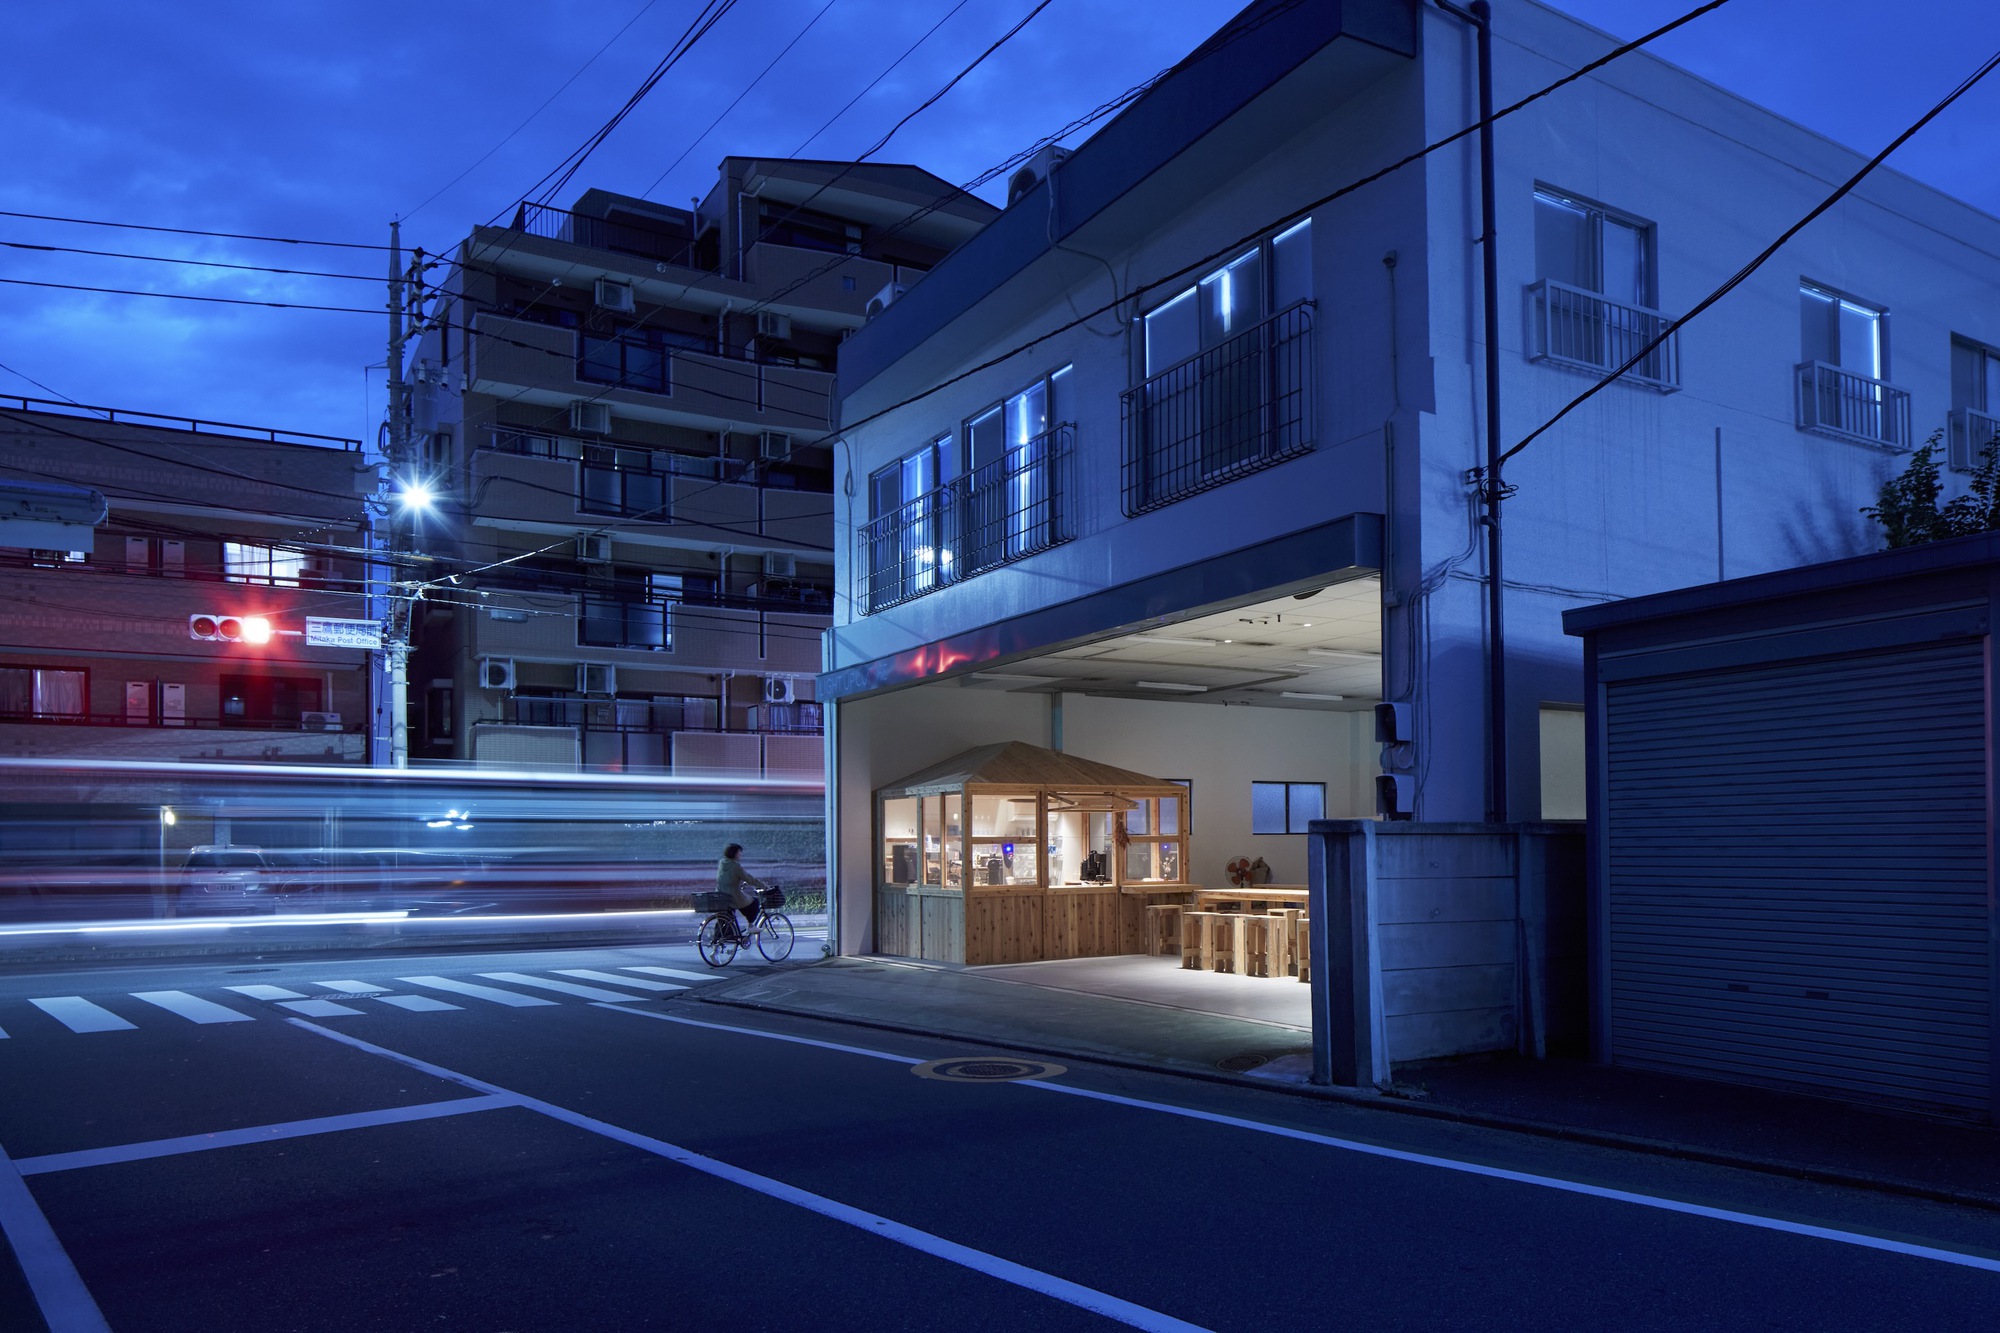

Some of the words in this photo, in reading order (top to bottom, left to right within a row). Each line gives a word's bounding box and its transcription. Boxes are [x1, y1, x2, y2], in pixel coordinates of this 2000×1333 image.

[311, 621, 377, 636] 三鷹郵便局前
[310, 635, 335, 643] Mitaka
[338, 636, 353, 644] Post
[356, 637, 377, 645] Office
